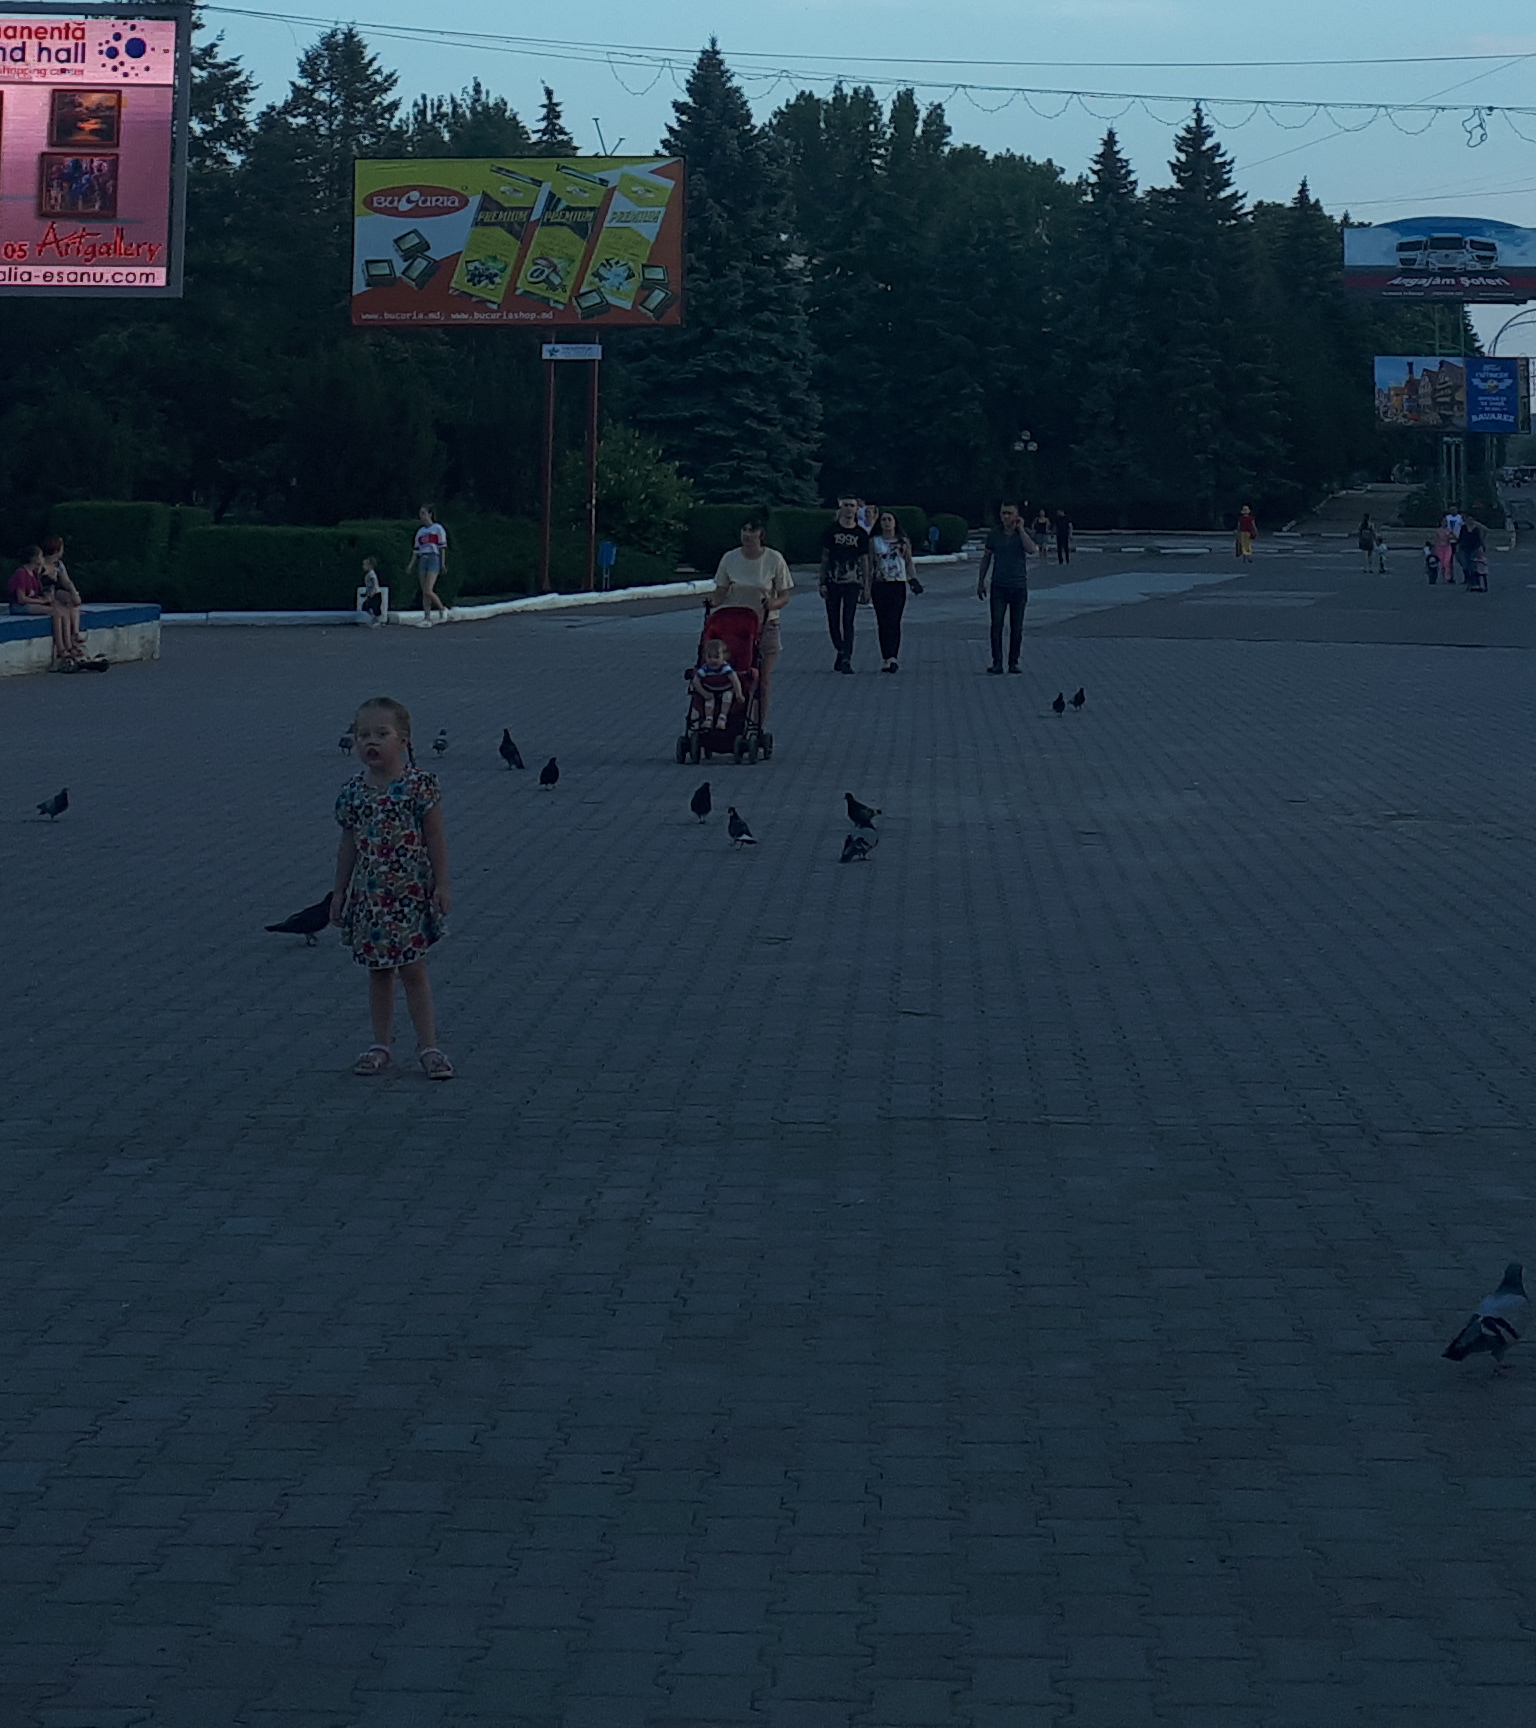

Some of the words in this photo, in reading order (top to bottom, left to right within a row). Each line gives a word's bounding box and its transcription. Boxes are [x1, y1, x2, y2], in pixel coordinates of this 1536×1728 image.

[37, 41, 86, 64] hall
[478, 210, 529, 223] PREMIUM
[544, 210, 596, 223] PREMIUM
[611, 210, 662, 223] PREMIUM
[3, 241, 30, 260] 05
